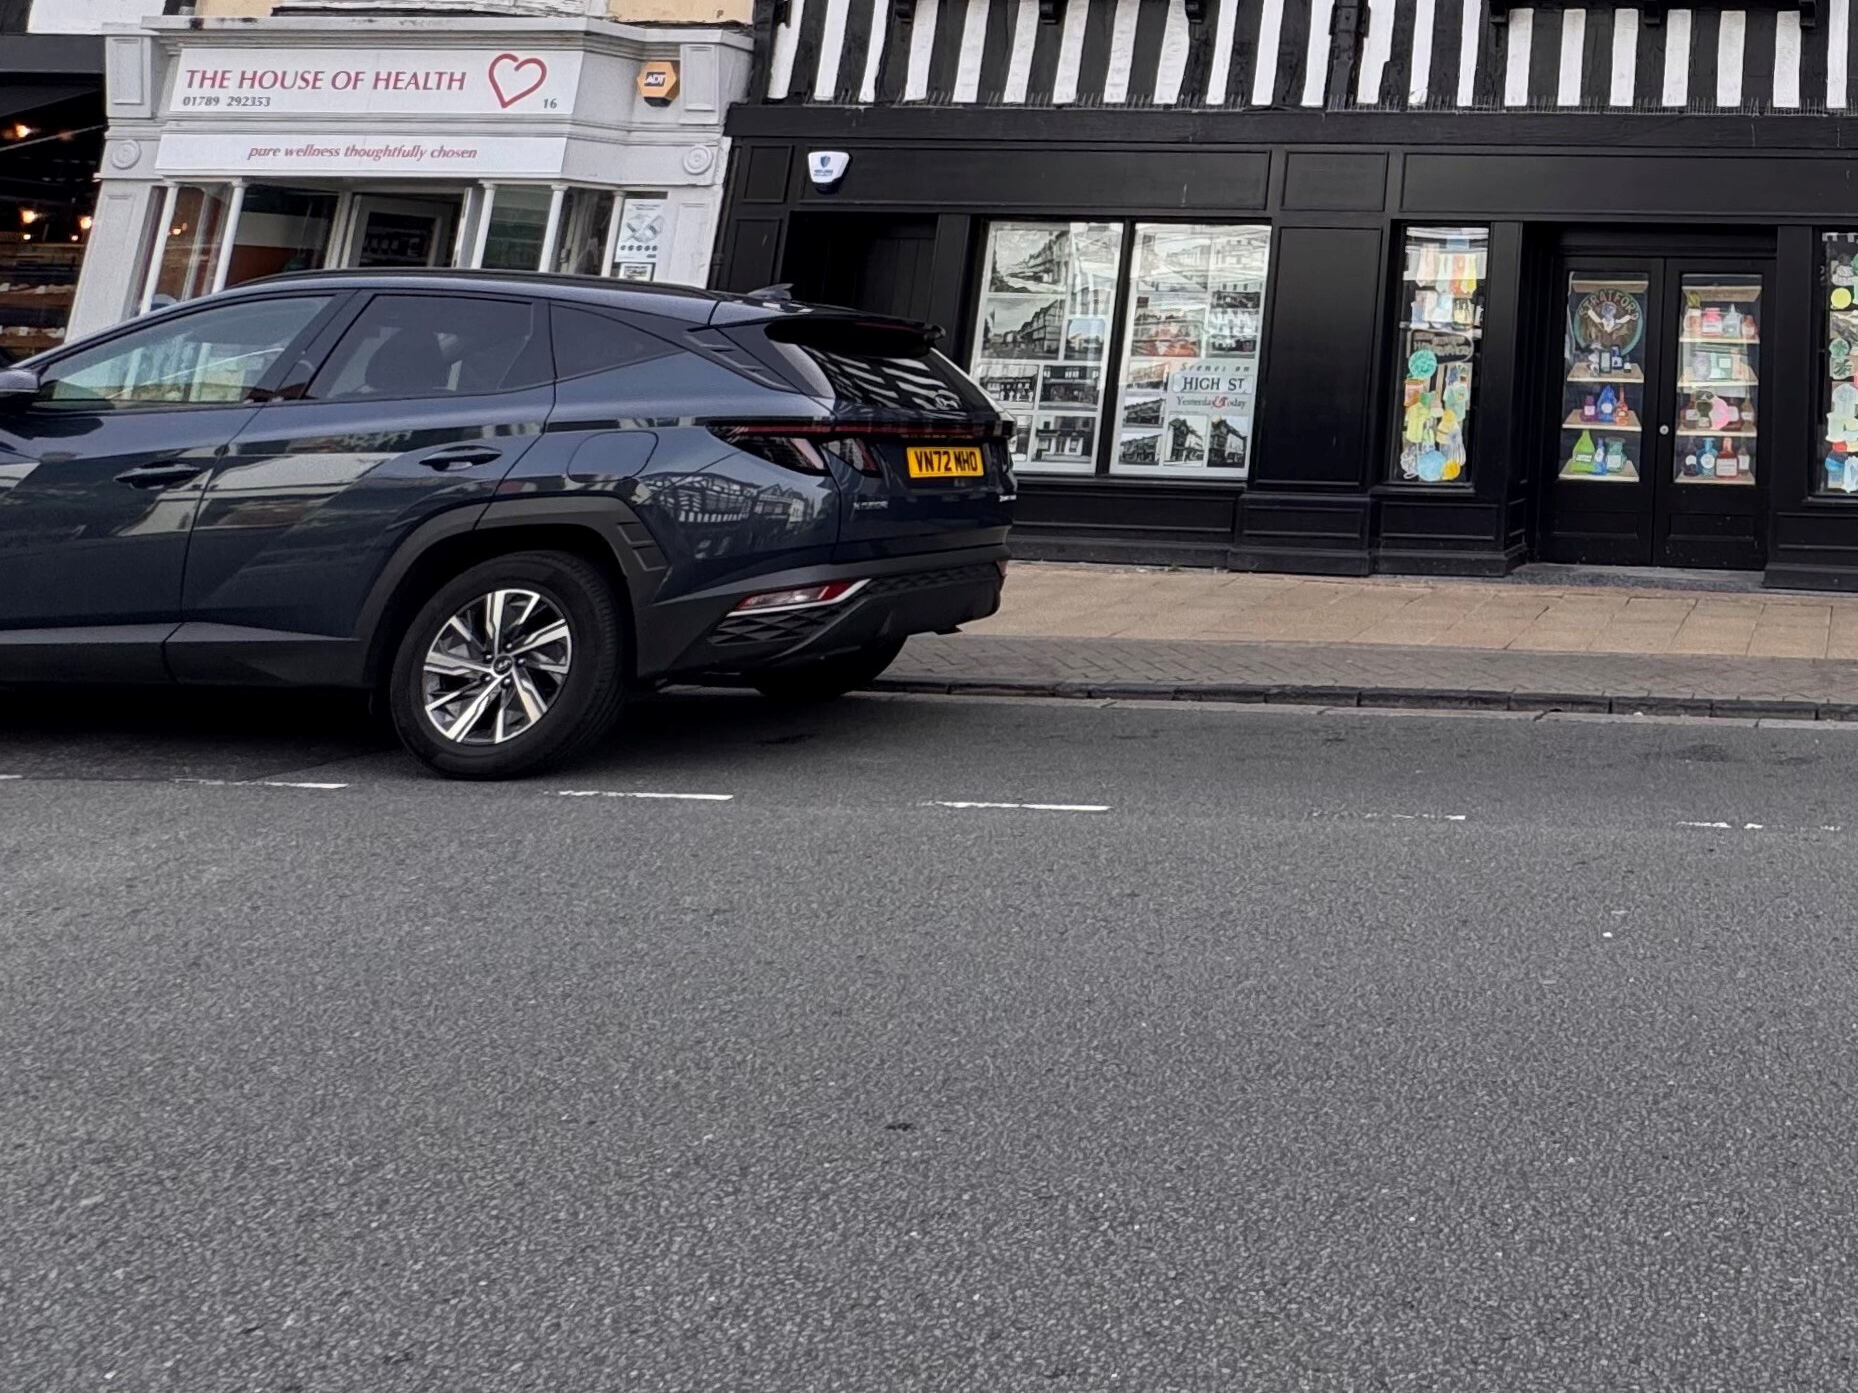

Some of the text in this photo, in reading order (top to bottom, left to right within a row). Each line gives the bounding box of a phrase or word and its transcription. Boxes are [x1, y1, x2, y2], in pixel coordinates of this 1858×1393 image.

[185, 69, 467, 91] THE HOUSE OF HEALTH
[645, 73, 667, 85] ADT
[182, 96, 220, 107] 01789
[226, 96, 271, 108] 292353
[543, 98, 558, 109] 16
[247, 144, 478, 162] pure wellness thoughtfully chosen
[1578, 290, 1640, 322] STRATFORD
[1183, 376, 1246, 391] HIGH ST
[914, 450, 951, 472] VN72
